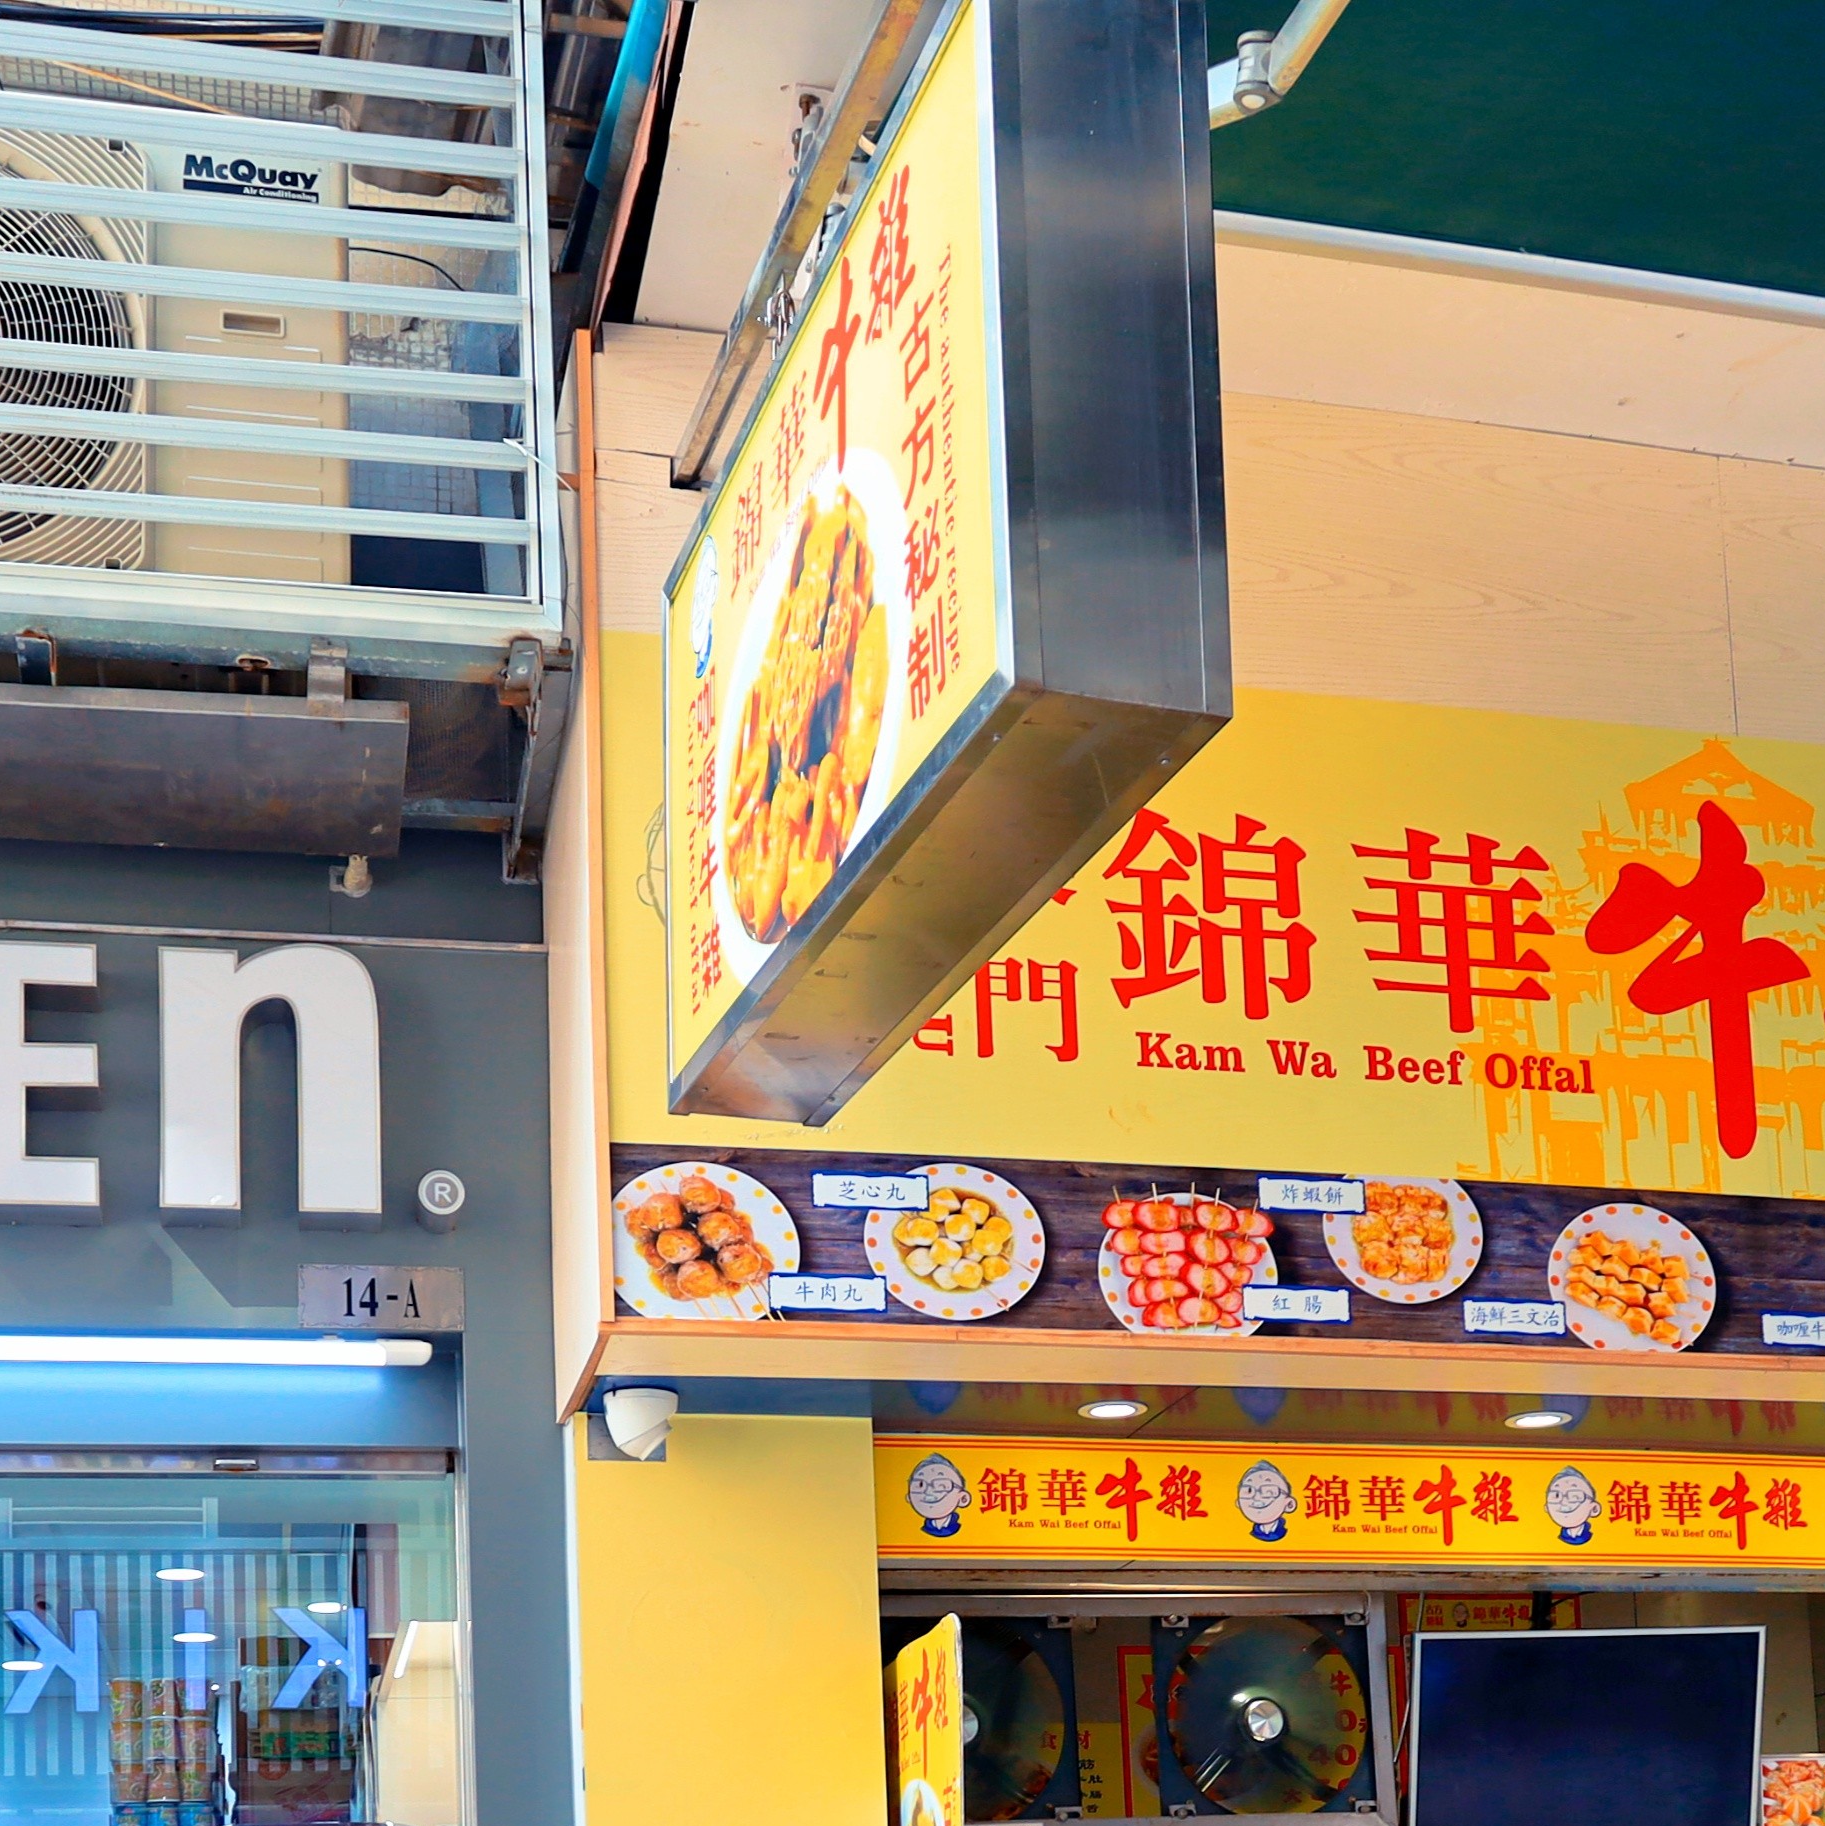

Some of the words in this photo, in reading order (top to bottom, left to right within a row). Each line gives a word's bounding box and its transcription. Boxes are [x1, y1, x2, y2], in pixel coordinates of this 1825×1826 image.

[183, 154, 318, 190] McQuay
[243, 186, 258, 195] Air
[259, 188, 317, 203] Conditioning
[1135, 1031, 1245, 1073] Kam
[1268, 1040, 1337, 1079] Wa
[1363, 1045, 1465, 1085] Beef
[1484, 1052, 1595, 1094] Offal
[838, 1180, 906, 1203] 芝心丸
[1282, 1184, 1345, 1207] 炸蝦餅
[342, 1277, 421, 1318] 14-A
[794, 1282, 864, 1305] 牛肉丸
[1272, 1293, 1324, 1315] 紅腸
[1470, 1304, 1562, 1330] 海鮮三文治
[1008, 1519, 1034, 1528] Kam
[1064, 1519, 1089, 1529] Beef
[1094, 1519, 1121, 1530] Offal
[1332, 1524, 1358, 1533] Kam
[1385, 1525, 1409, 1534] Beef
[1412, 1525, 1438, 1535] Offal
[1634, 1527, 1657, 1536] Kam
[1683, 1528, 1706, 1538] Beef
[1709, 1528, 1732, 1538] Offal
